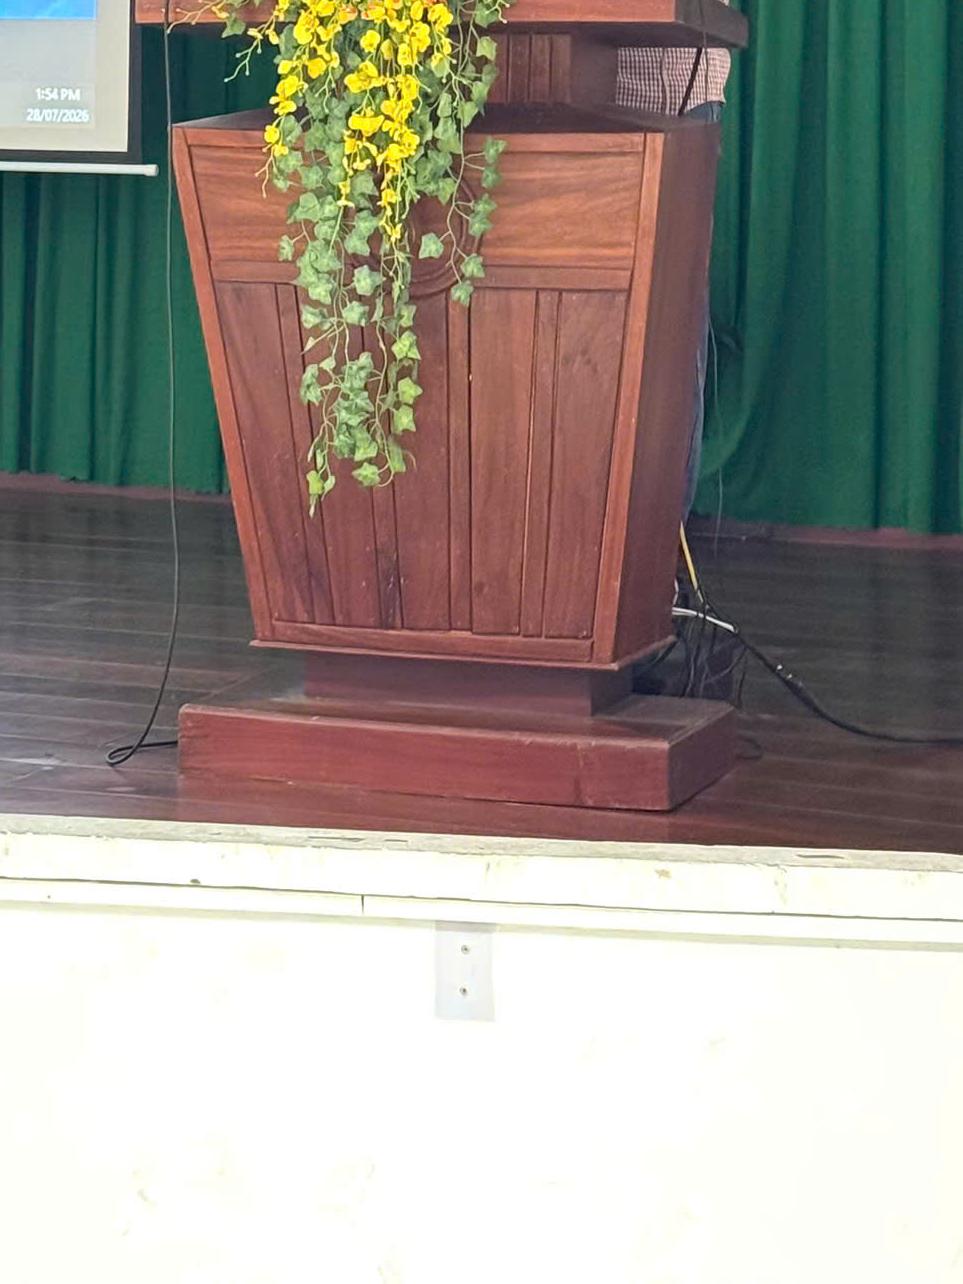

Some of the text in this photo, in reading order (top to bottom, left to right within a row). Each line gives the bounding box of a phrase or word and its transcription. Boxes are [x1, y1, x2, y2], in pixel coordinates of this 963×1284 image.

[35, 87, 81, 101] 1:54 PM
[26, 107, 90, 123] 28/07/2026
